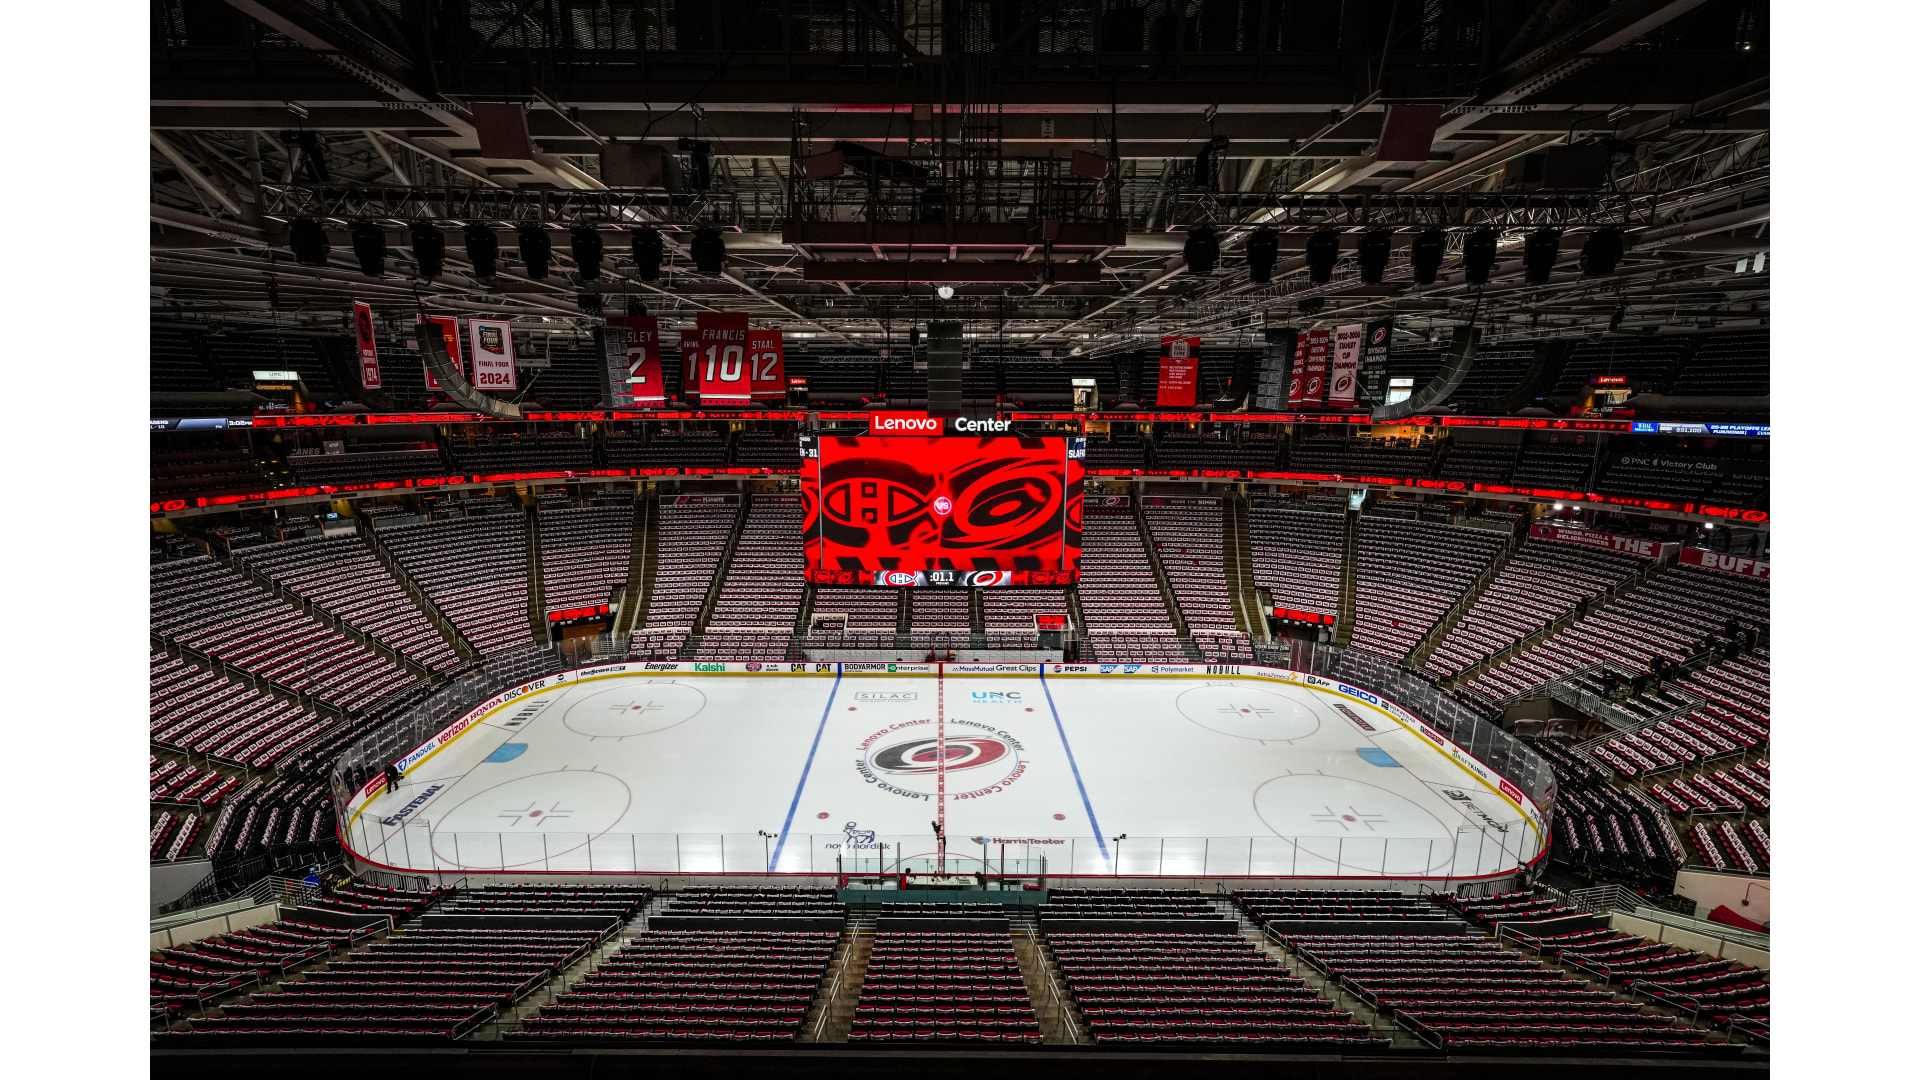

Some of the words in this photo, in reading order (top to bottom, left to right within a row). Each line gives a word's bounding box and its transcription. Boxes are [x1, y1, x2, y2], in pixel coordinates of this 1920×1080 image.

[622, 332, 652, 343] SLEY
[702, 330, 746, 340] FRANCIS
[752, 340, 774, 350] STAAL
[626, 346, 646, 384] 2
[706, 344, 744, 382] 10
[751, 352, 778, 381] 12
[480, 373, 510, 385] 2024
[874, 416, 937, 430] Lenovo
[954, 417, 1012, 431] Center
[290, 448, 320, 456] CANES
[1660, 460, 1693, 470] Victory
[1696, 462, 1717, 470] Club
[1557, 533, 1609, 546] DELICIOUSNESS
[1584, 532, 1602, 540] PIZZA
[1613, 537, 1652, 555] THE
[930, 572, 954, 581] :01.1
[644, 662, 678, 671] Energizer
[694, 663, 725, 672] Kalshi
[791, 664, 806, 672] CAT
[816, 664, 831, 672] CAT
[1207, 665, 1240, 674] NOBULL
[1257, 672, 1290, 680] AstraZeneca
[504, 680, 545, 702] DISCOVER
[1339, 684, 1377, 704] GEICO
[470, 698, 502, 721] HONDA
[504, 700, 549, 726] NOBULL
[438, 717, 469, 744] verizon
[856, 727, 888, 751] Lenovo
[890, 719, 931, 731] Center
[950, 718, 995, 732] Lenovo
[997, 730, 1025, 752] Center
[408, 742, 436, 764] FANDUEL
[856, 759, 877, 784] Center
[1002, 760, 1030, 786] Lenovo
[1452, 752, 1487, 778] DRAFTKINGS
[366, 777, 386, 794] Lenovo
[878, 782, 930, 802] Lenovo
[954, 785, 1003, 801] Center
[1501, 782, 1521, 801] Lenovo
[382, 784, 445, 826] FASTENAL
[1462, 801, 1509, 832] BETMGM
